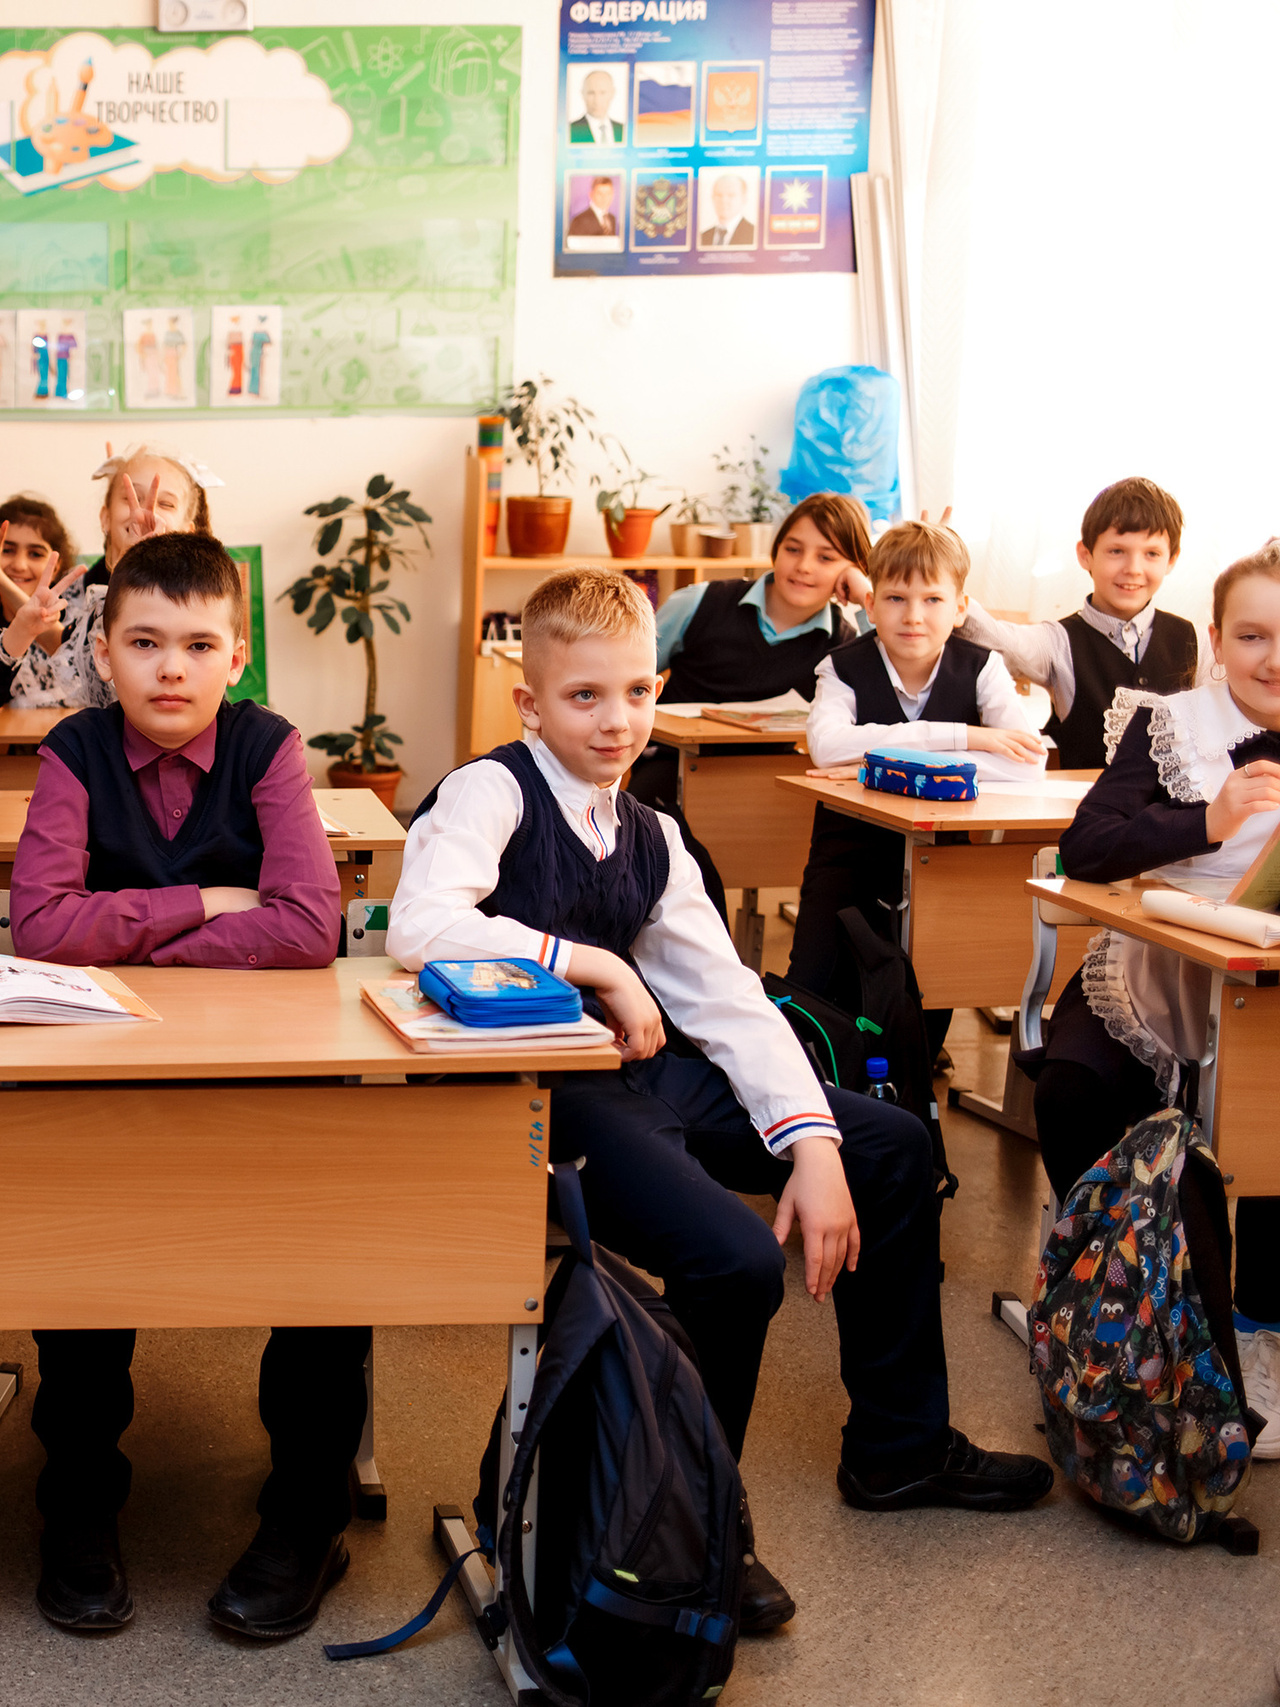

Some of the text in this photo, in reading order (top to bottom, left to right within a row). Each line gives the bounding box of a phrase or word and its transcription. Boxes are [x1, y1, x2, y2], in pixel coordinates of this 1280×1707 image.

[570, 1, 707, 26] ФЕДЕРАЦИЯ
[128, 71, 184, 94] НАШЕ
[96, 100, 219, 123] ТВОРЧЕСТВО
